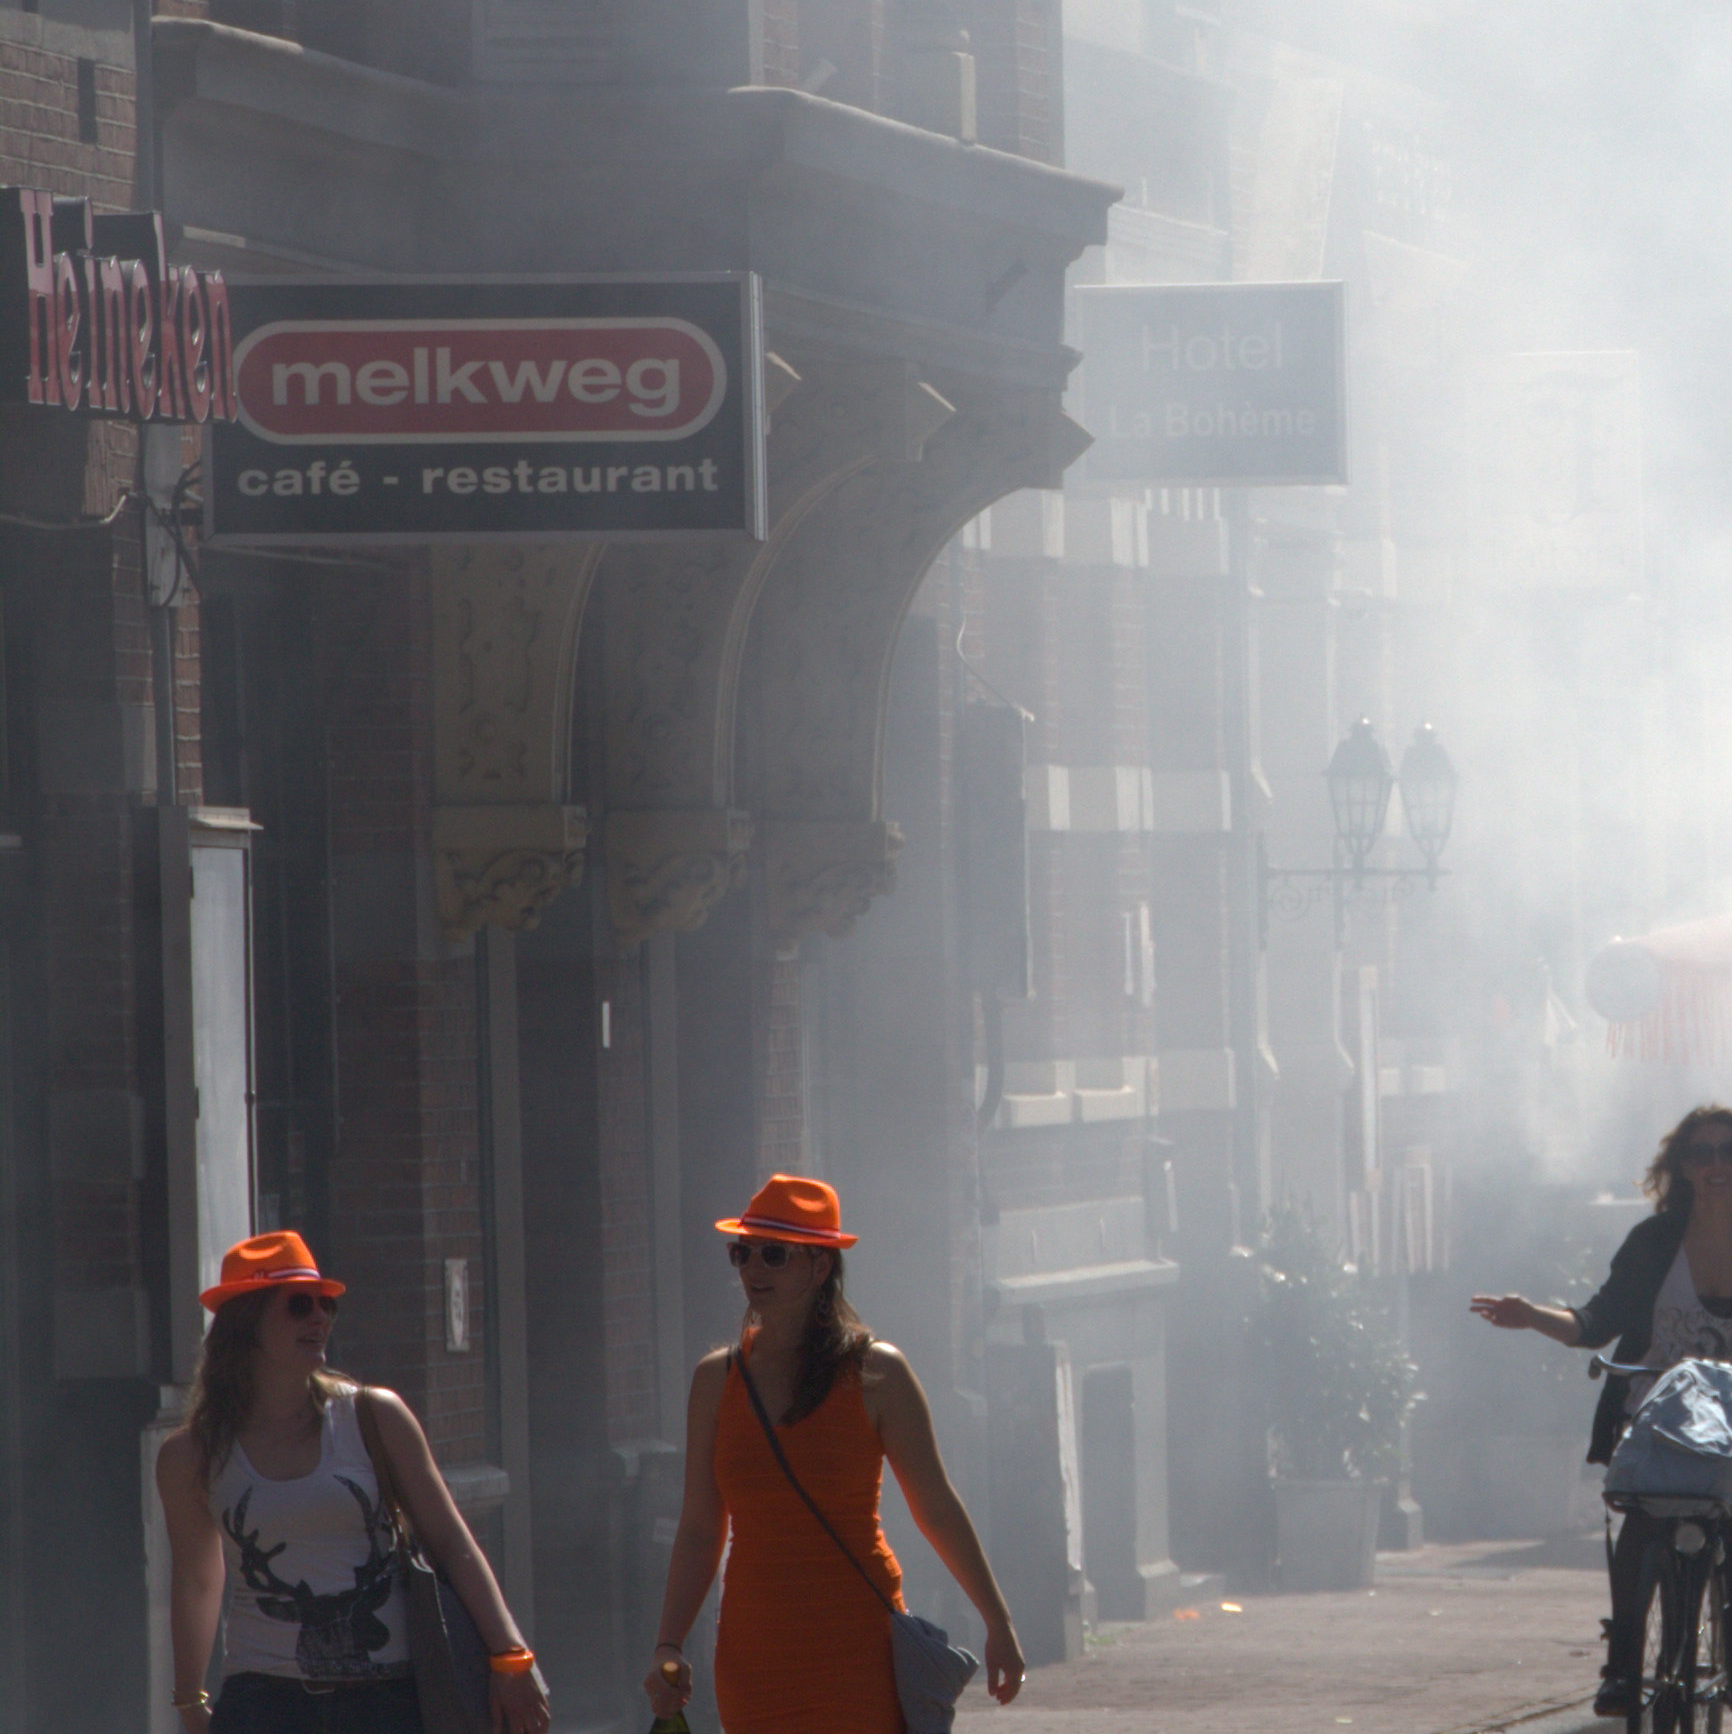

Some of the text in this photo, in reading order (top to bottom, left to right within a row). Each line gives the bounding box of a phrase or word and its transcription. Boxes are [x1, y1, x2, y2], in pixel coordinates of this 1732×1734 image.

[20, 186, 238, 424] Heineken
[1141, 321, 1283, 370] Hotel
[272, 347, 681, 417] melkweg
[1109, 400, 1316, 438] La Bohème
[237, 460, 361, 496] café
[421, 458, 719, 495] restaurant
